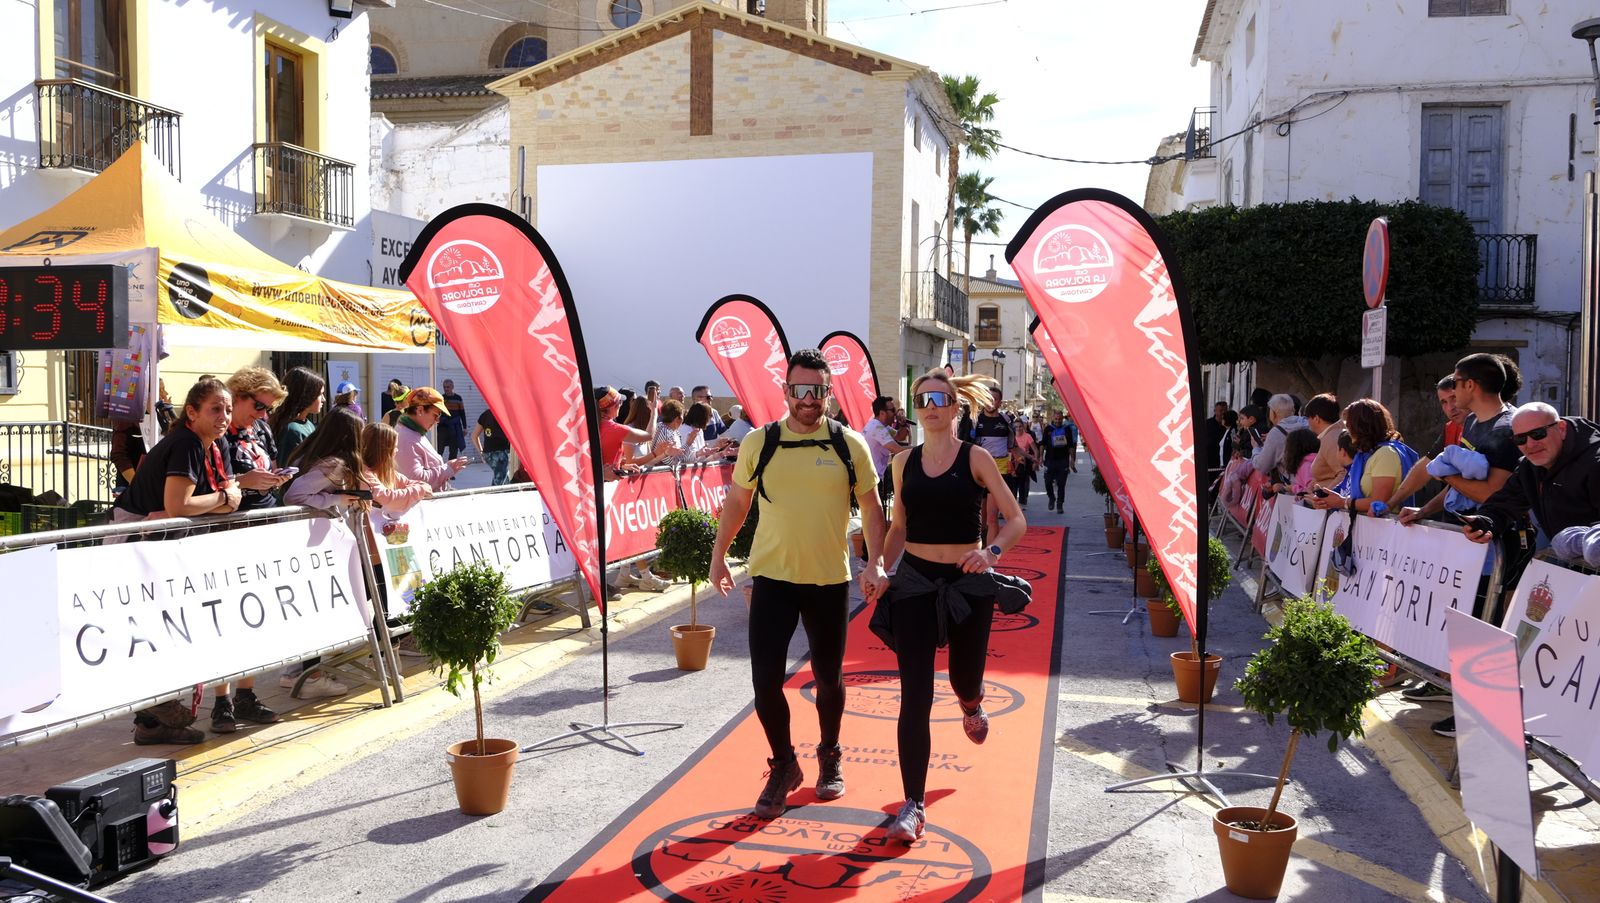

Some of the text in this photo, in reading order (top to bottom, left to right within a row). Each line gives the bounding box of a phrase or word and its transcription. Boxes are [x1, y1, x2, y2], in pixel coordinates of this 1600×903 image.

[176, 279, 190, 287] uno
[0, 276, 107, 340] :34
[426, 515, 537, 542] AYUNTAMIENTO
[612, 496, 668, 535] VEOLIA
[72, 550, 335, 612] AYUNTAMIENTO DE
[1438, 566, 1463, 589] DE
[75, 575, 350, 666] CANTORIA
[706, 819, 888, 848] POLVORA
